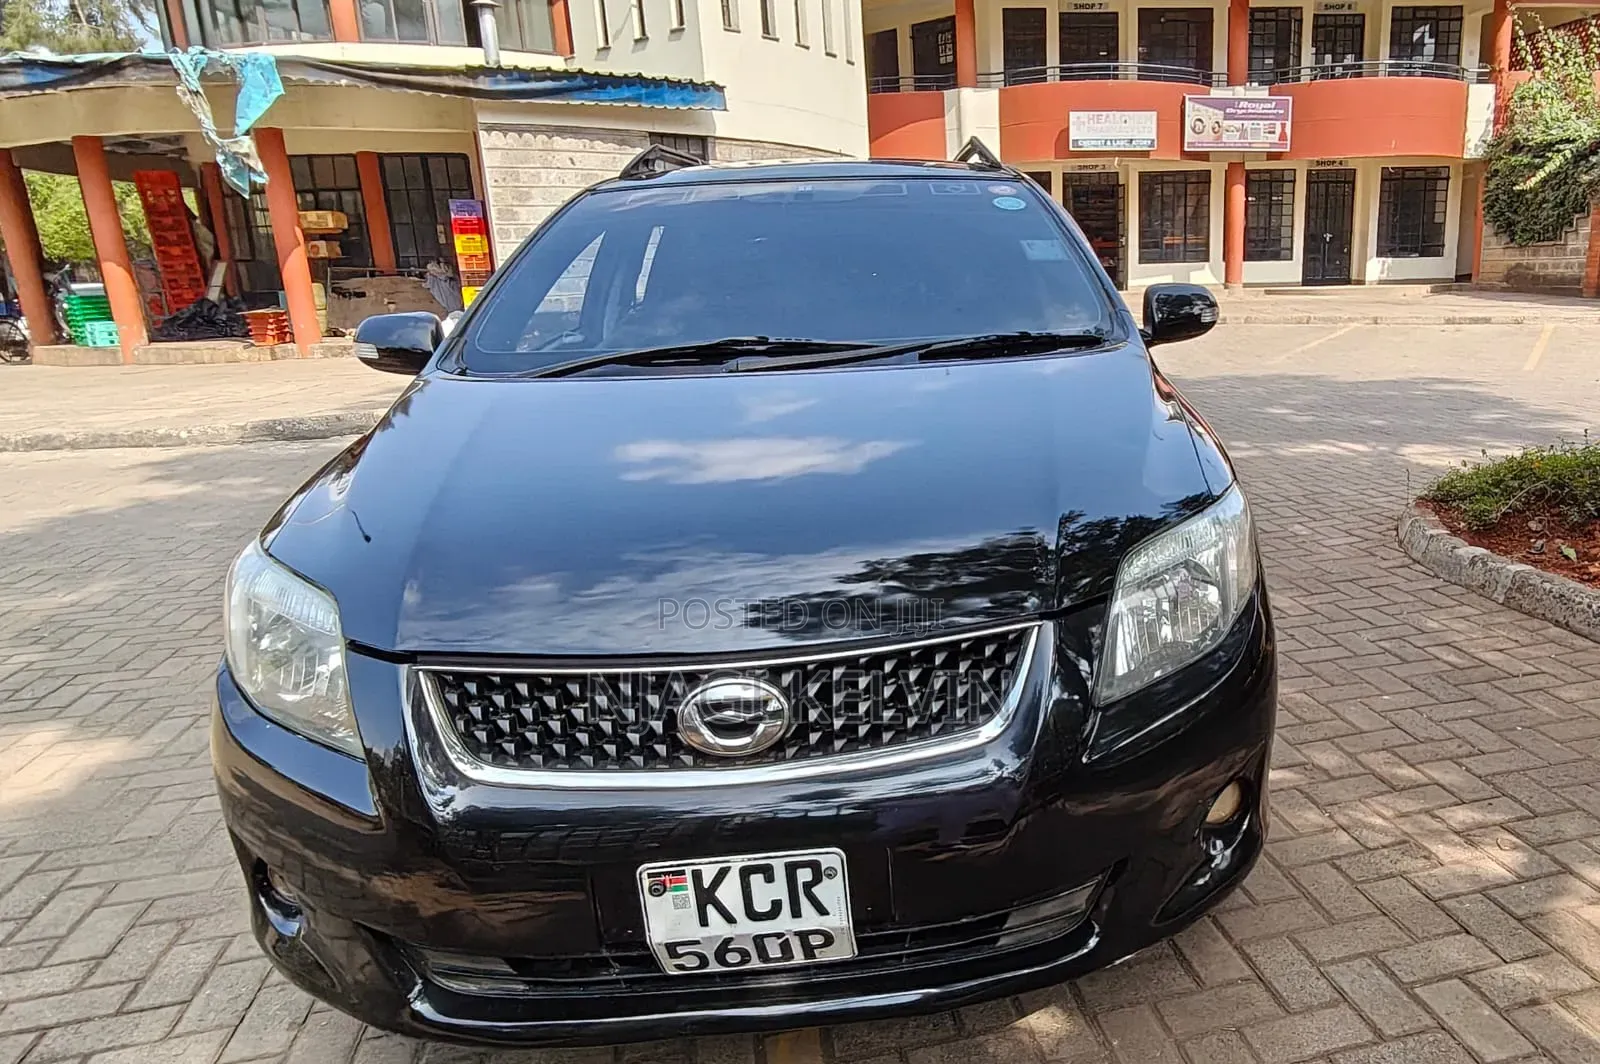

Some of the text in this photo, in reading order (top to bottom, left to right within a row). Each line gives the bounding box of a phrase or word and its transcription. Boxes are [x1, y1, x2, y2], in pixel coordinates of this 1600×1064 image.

[1073, 2, 1104, 10] SHOP 7
[1324, 3, 1345, 11] SHOP
[1238, 101, 1277, 110] Royal
[1078, 139, 1104, 147] CHEMIST
[1315, 159, 1344, 167] SHOP 4
[691, 859, 830, 928] KCR
[664, 927, 835, 971] 560P
